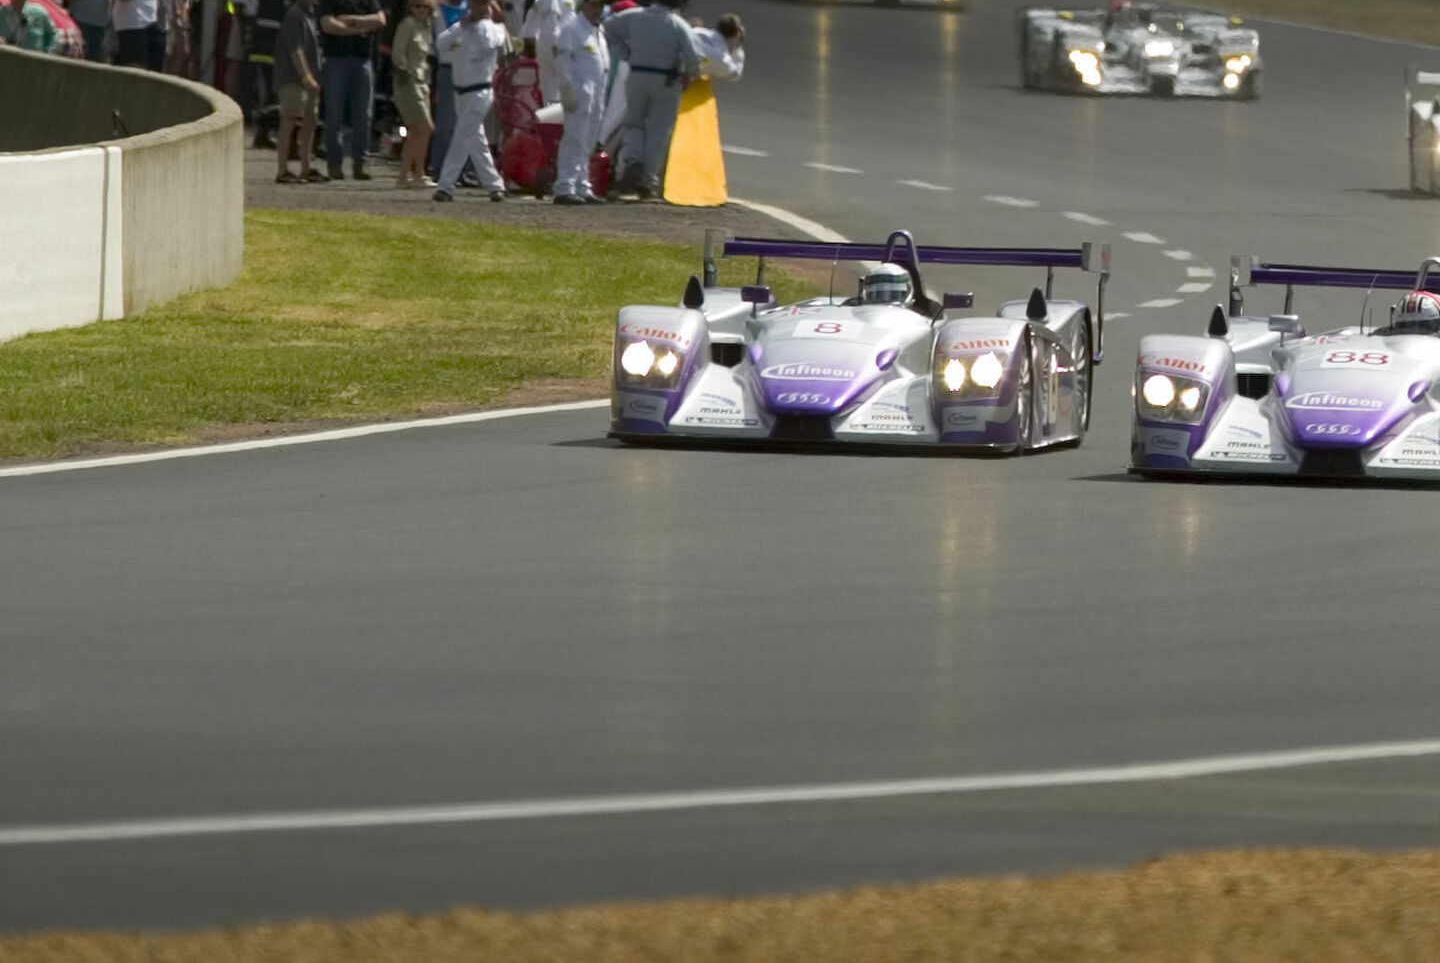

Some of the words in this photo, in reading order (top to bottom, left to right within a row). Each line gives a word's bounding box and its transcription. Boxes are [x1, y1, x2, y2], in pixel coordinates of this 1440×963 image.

[814, 322, 843, 335] 8
[1325, 351, 1389, 366] 88
[775, 362, 857, 379] Infineon
[1301, 392, 1384, 409] Infineon
